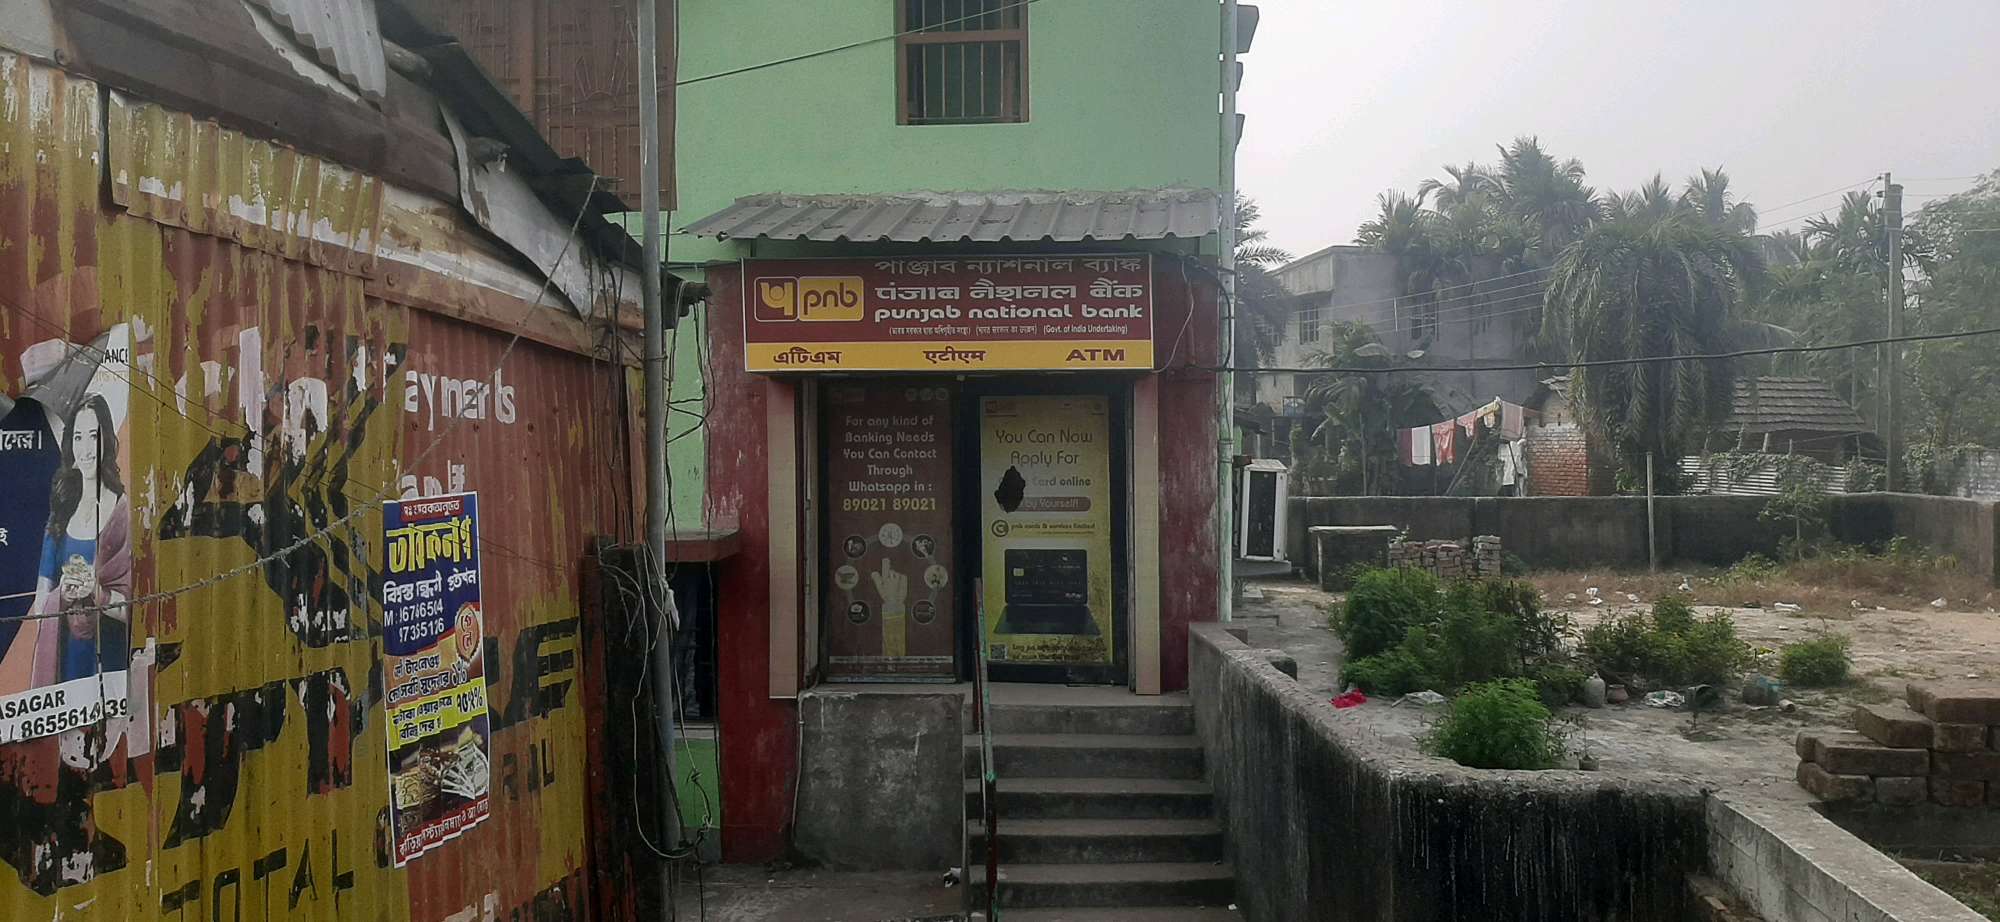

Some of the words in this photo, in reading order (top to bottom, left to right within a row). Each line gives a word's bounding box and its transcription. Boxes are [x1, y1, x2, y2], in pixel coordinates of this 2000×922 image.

[874, 259, 958, 275] পাঞ্জাব
[967, 257, 1074, 275] ন্যাশনাল
[874, 281, 960, 300] पंजाब
[1089, 277, 1143, 299] बैंक
[803, 281, 858, 316] pnb
[874, 304, 961, 322] punjab
[968, 304, 1072, 319] national
[1082, 303, 1143, 319] bank
[1063, 325, 1071, 334] of
[1071, 325, 1087, 334] India
[1087, 324, 1128, 336] Undertaking)
[773, 347, 842, 365] এটিএম
[922, 346, 986, 364] एटीएम
[1065, 348, 1125, 362] ATM
[846, 416, 863, 426] For
[867, 418, 889, 429] any
[893, 415, 918, 426] kind
[922, 414, 934, 426] of
[844, 432, 893, 445] Banking
[896, 432, 935, 443] Needs
[995, 429, 1023, 444] You
[1027, 429, 1055, 443] Can
[1060, 427, 1093, 443] Now
[842, 448, 865, 459] You
[868, 448, 890, 459] Can
[893, 448, 937, 459] Contact
[1010, 450, 1052, 467] Apply
[1056, 450, 1080, 464] For
[867, 464, 913, 478] Through
[848, 481, 911, 494] Whatsapp
[914, 481, 925, 491] in
[1059, 476, 1091, 486] online
[842, 498, 886, 511] 89021
[892, 498, 936, 511] 89021
